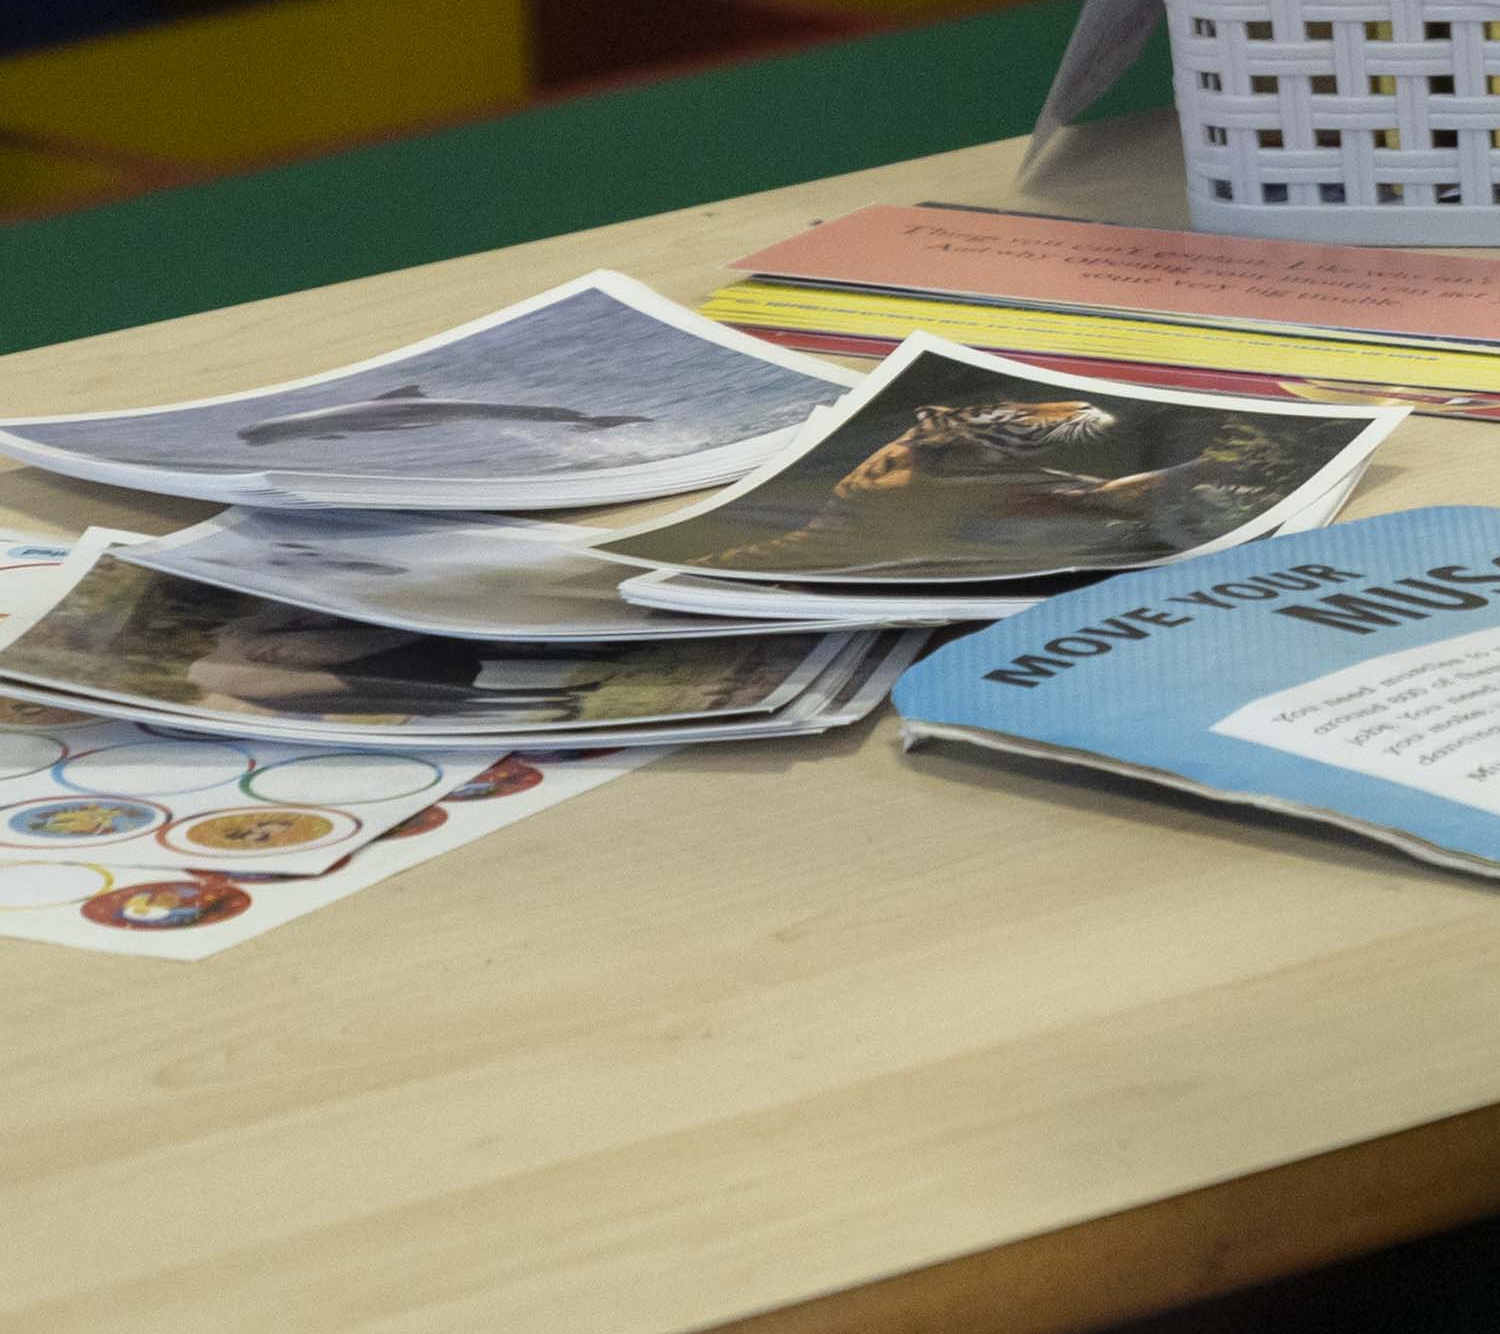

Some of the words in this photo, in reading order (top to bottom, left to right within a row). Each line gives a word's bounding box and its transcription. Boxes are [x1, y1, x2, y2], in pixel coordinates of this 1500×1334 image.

[977, 607, 1195, 689] MOVE
[1163, 563, 1367, 610] YOUR
[1271, 705, 1320, 723] You
[1321, 685, 1377, 708] need
[1312, 703, 1390, 736] around
[1382, 733, 1424, 757] you
